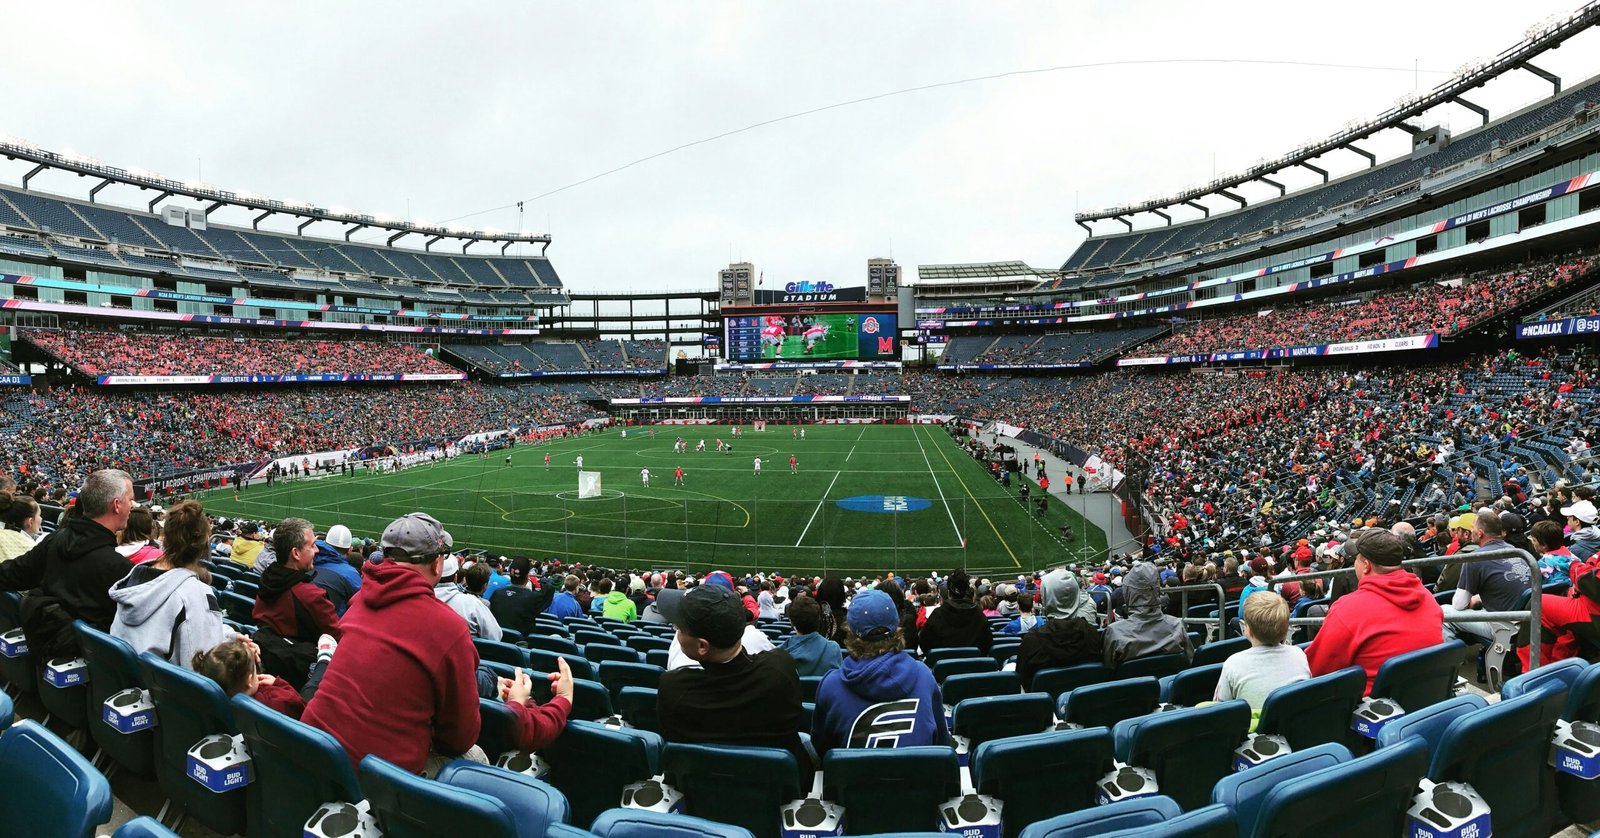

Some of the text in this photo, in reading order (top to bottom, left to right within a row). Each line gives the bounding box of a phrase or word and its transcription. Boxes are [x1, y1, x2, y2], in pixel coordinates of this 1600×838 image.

[1455, 216, 1467, 226] NCAA
[1473, 209, 1488, 220] MEN'S
[1488, 201, 1513, 216] LACROSSE
[1513, 189, 1553, 210] CHAMPIONSHIP
[1354, 268, 1375, 279] MARYLAND
[786, 280, 834, 294] Gillette
[783, 294, 837, 302] STADIUM
[1521, 322, 1563, 337] #NCAALAX
[1292, 347, 1317, 356] MARYLAND
[162, 476, 192, 490] LACROSSE
[108, 715, 120, 726] LIGHT
[109, 710, 118, 720] BUD
[132, 719, 149, 727] LIGHT
[1358, 722, 1369, 730] BUD
[1565, 756, 1581, 765] BUD
[195, 763, 207, 776] BUD
[1562, 761, 1584, 772] LIGHT
[193, 769, 209, 783] LIGHT
[224, 776, 244, 787] LIGHT
[226, 771, 242, 781] BUD
[964, 829, 981, 837] BUD
[1418, 828, 1434, 838] BUD
[1461, 823, 1477, 836] BUD
